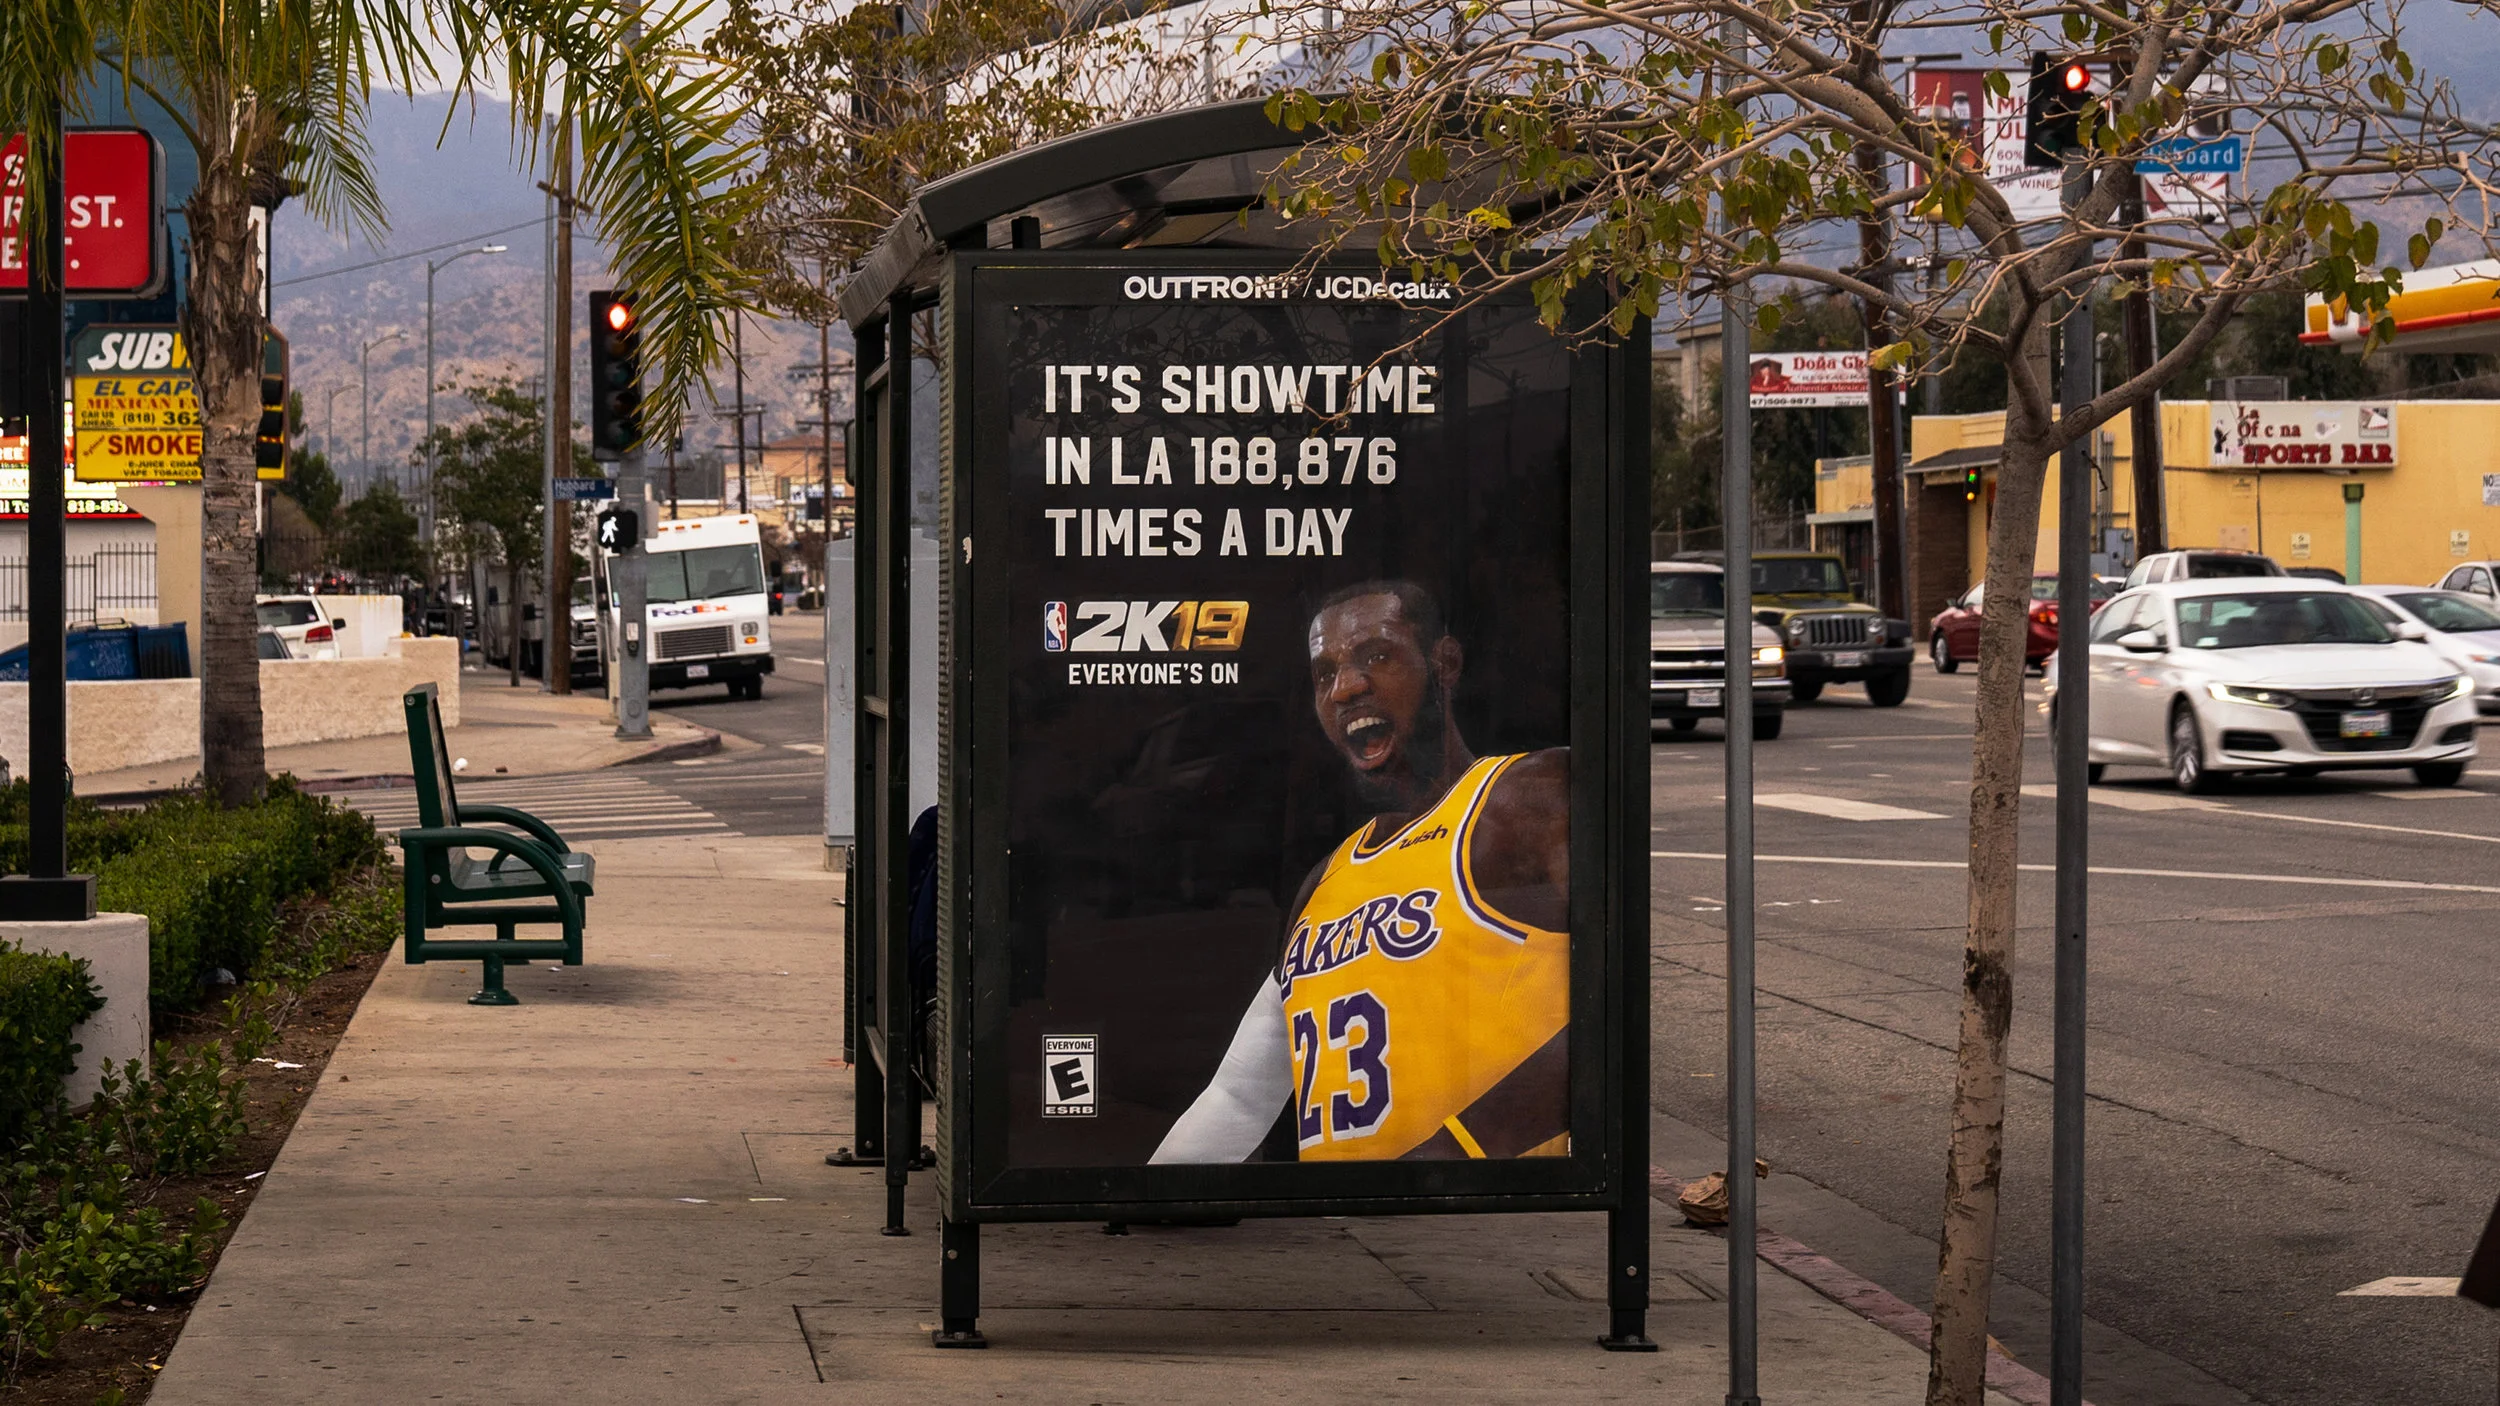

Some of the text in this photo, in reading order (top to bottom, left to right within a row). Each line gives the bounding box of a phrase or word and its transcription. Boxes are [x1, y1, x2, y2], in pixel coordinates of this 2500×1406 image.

[1997, 149, 2023, 161] 60%
[1123, 275, 1297, 300] OUTFRONT
[1315, 276, 1452, 300] JCDecaux
[94, 380, 126, 397] EL
[1045, 365, 1436, 414] IT'S SHOWTIME
[87, 398, 171, 409] MEXICAN
[122, 412, 155, 425] (818)
[1045, 436, 1397, 491] IN LA 188,876
[2243, 444, 2393, 464] SPORTS BAR
[1045, 508, 1353, 556] TIMES A DAY
[651, 603, 729, 618] FedEx
[1070, 600, 1250, 652] 2K19
[1068, 662, 1239, 685] EVERYONE'S ON
[1398, 823, 1449, 850] wish
[1047, 1040, 1093, 1050] EVERYONE
[1049, 1056, 1091, 1102] E
[1293, 988, 1393, 1151] 23
[1045, 1106, 1094, 1115] ESRB
